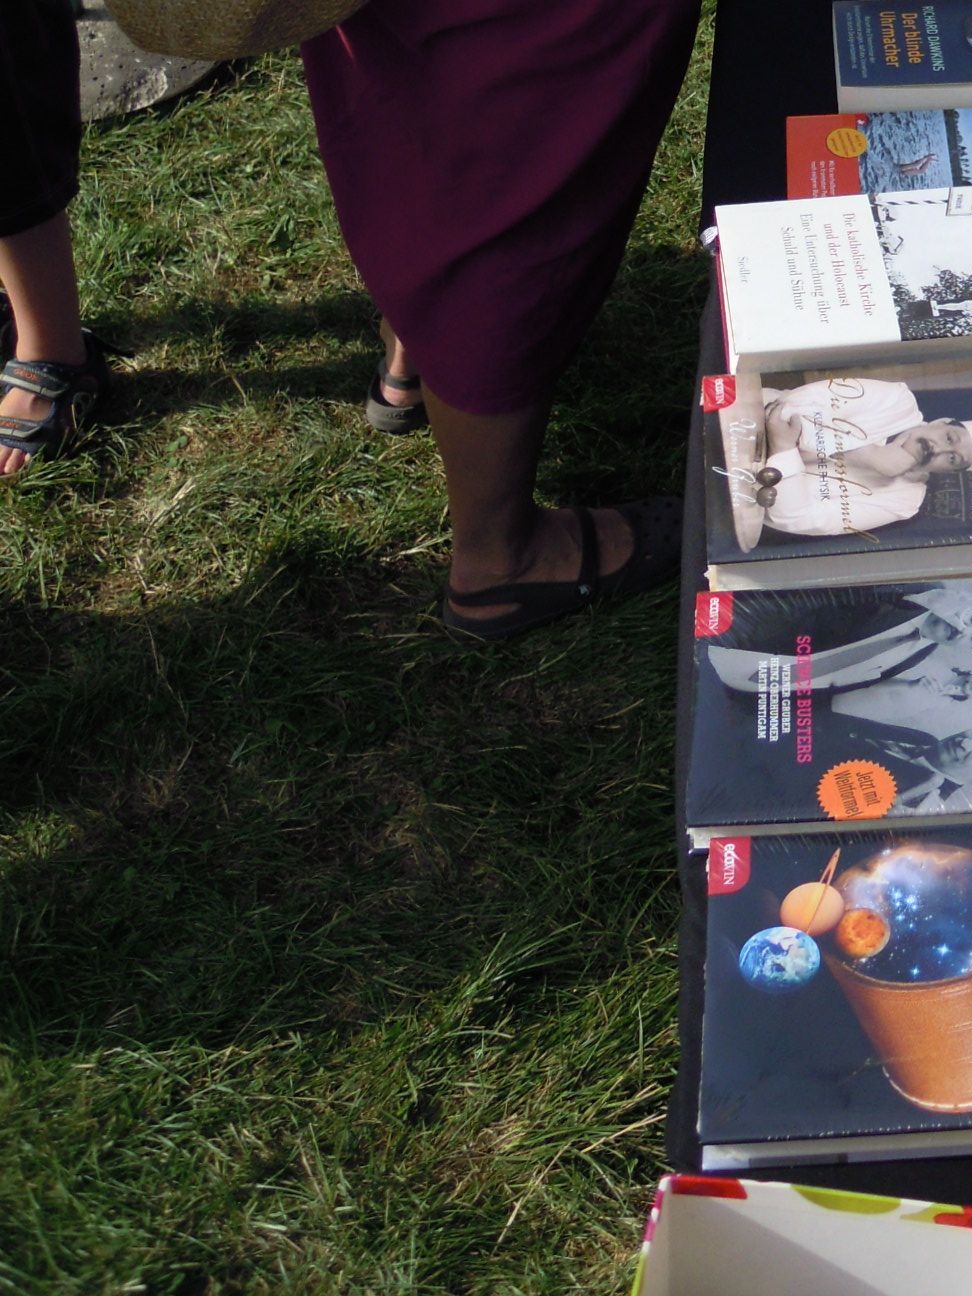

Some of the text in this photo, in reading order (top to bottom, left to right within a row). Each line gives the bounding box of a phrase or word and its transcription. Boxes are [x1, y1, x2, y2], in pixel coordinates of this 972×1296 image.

[880, 11, 900, 67] Uhrmacher
[901, 13, 924, 64] Der blinde
[922, 6, 945, 71] RICHARD DAWKINS
[781, 227, 805, 311] Schuld und Sühne
[799, 214, 831, 324] Eine Untersuchung über
[823, 224, 850, 307] und der Holocaust
[842, 213, 877, 316] Die katholische Kirche
[827, 378, 864, 409] Die
[818, 471, 831, 501] PHYSIK
[758, 661, 767, 738] MARTIN PUNTIGAM
[769, 657, 778, 741] HEINZ OBERHUMMER
[782, 664, 790, 734] WERNER GRUBER
[796, 699, 812, 763] BUSTERS
[856, 771, 882, 807] Jetzt mit
